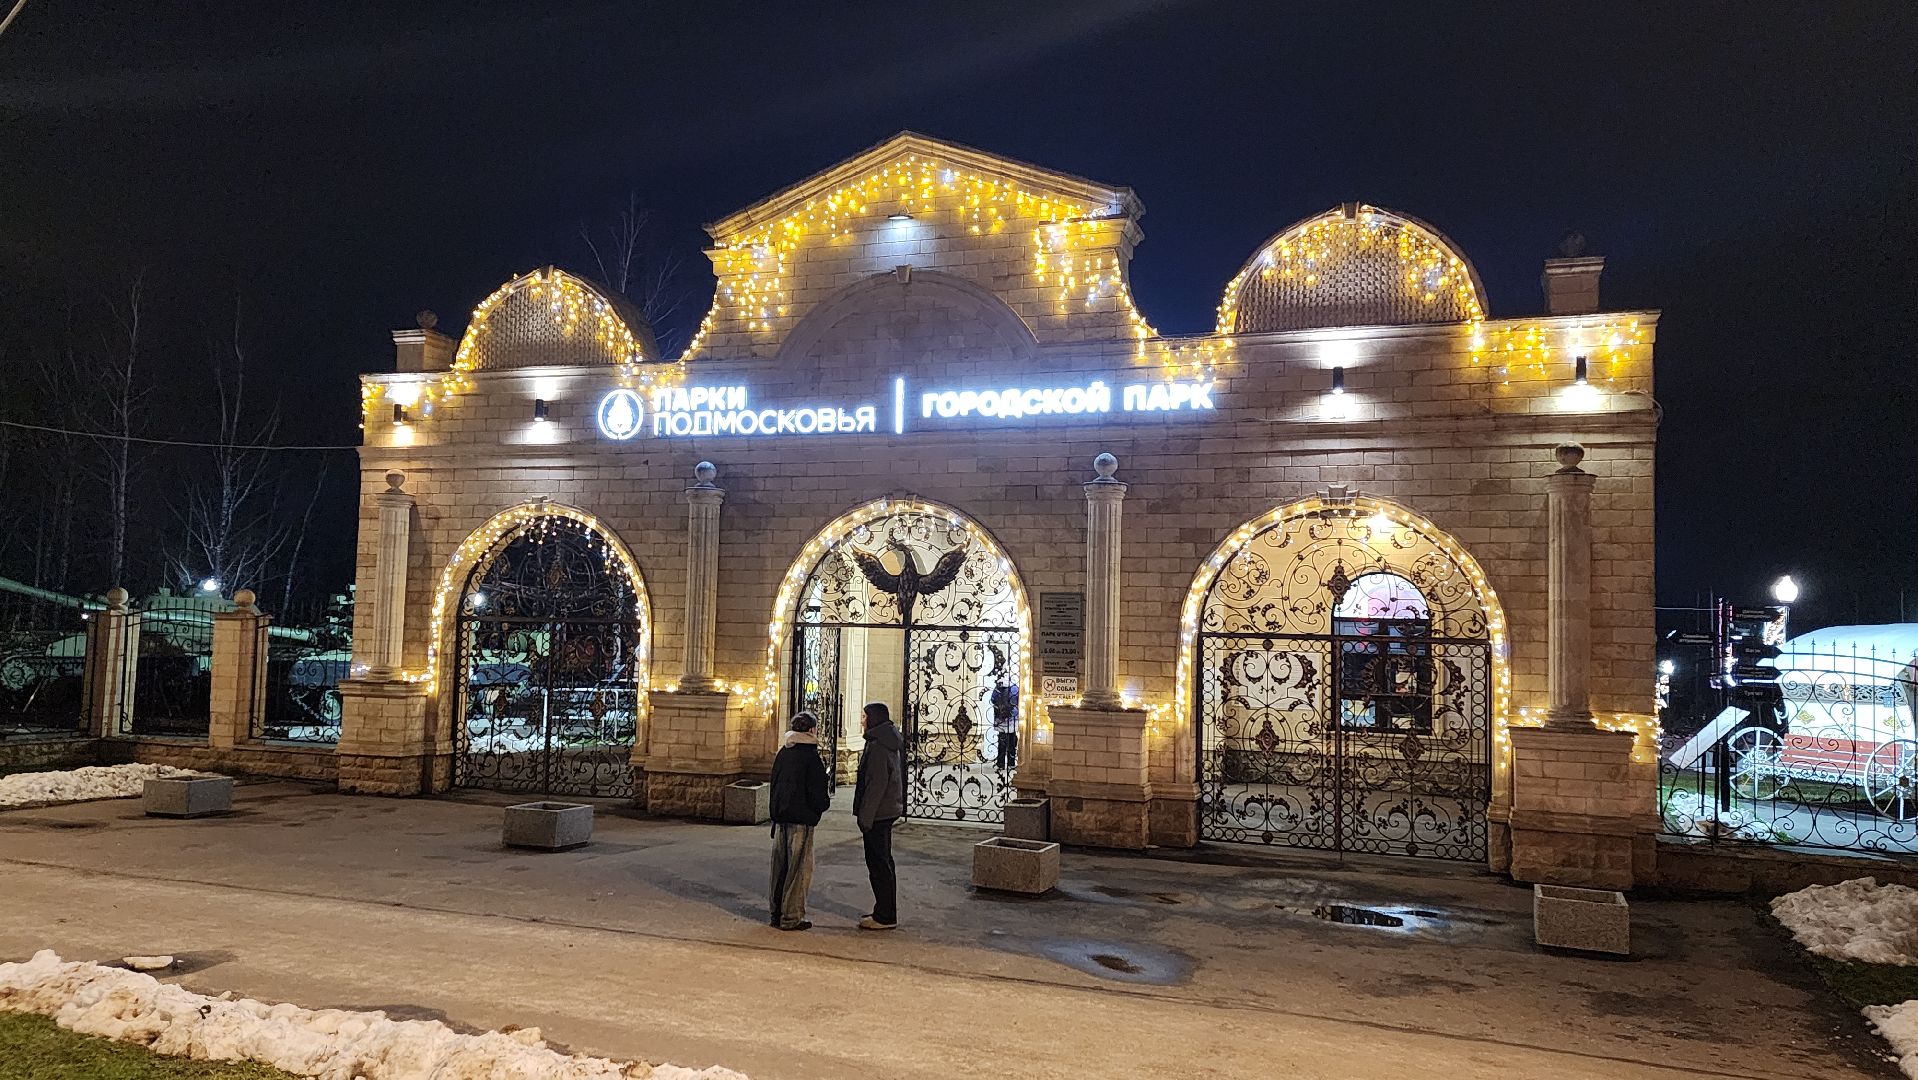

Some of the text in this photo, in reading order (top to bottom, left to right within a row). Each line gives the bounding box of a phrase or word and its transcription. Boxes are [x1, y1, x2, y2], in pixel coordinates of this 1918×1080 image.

[652, 386, 747, 411] ПАРКИ
[922, 381, 1214, 418] ГОРОДСКОЙ ПАРК
[653, 406, 877, 436] ПОДМОСКОВЬЯ
